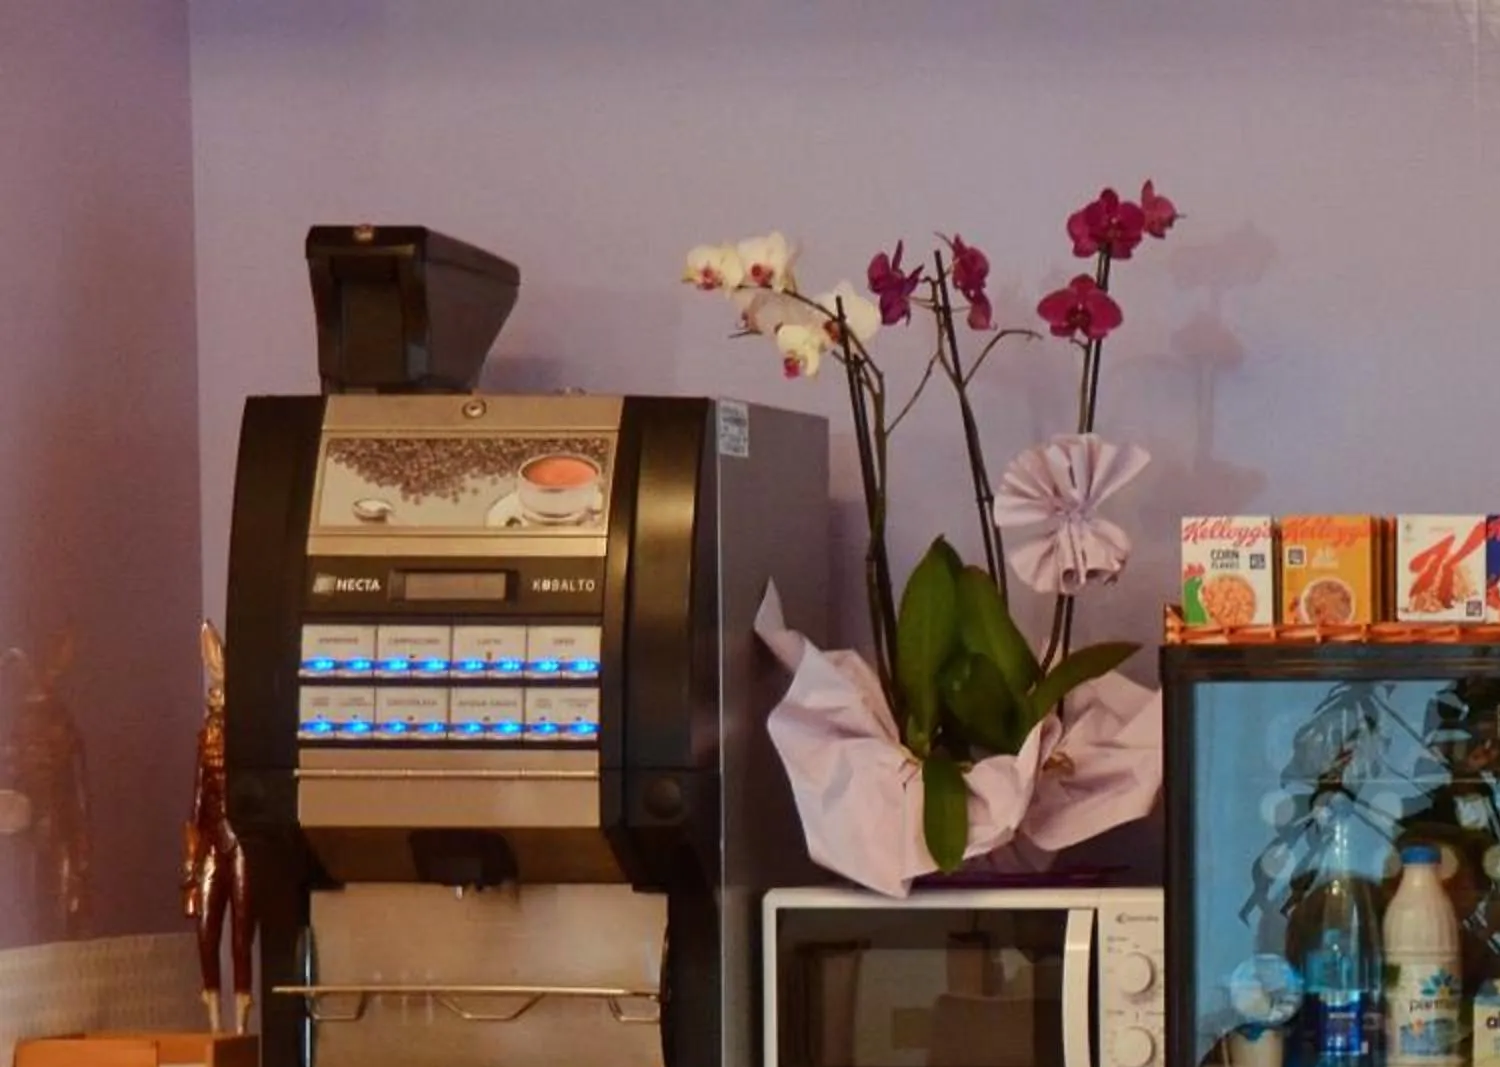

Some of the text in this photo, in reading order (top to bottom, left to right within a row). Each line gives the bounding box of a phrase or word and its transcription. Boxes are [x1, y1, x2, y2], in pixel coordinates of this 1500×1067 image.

[1183, 515, 1272, 547] Kellogg's
[1210, 549, 1239, 560] CORN
[336, 578, 381, 592] NECTA
